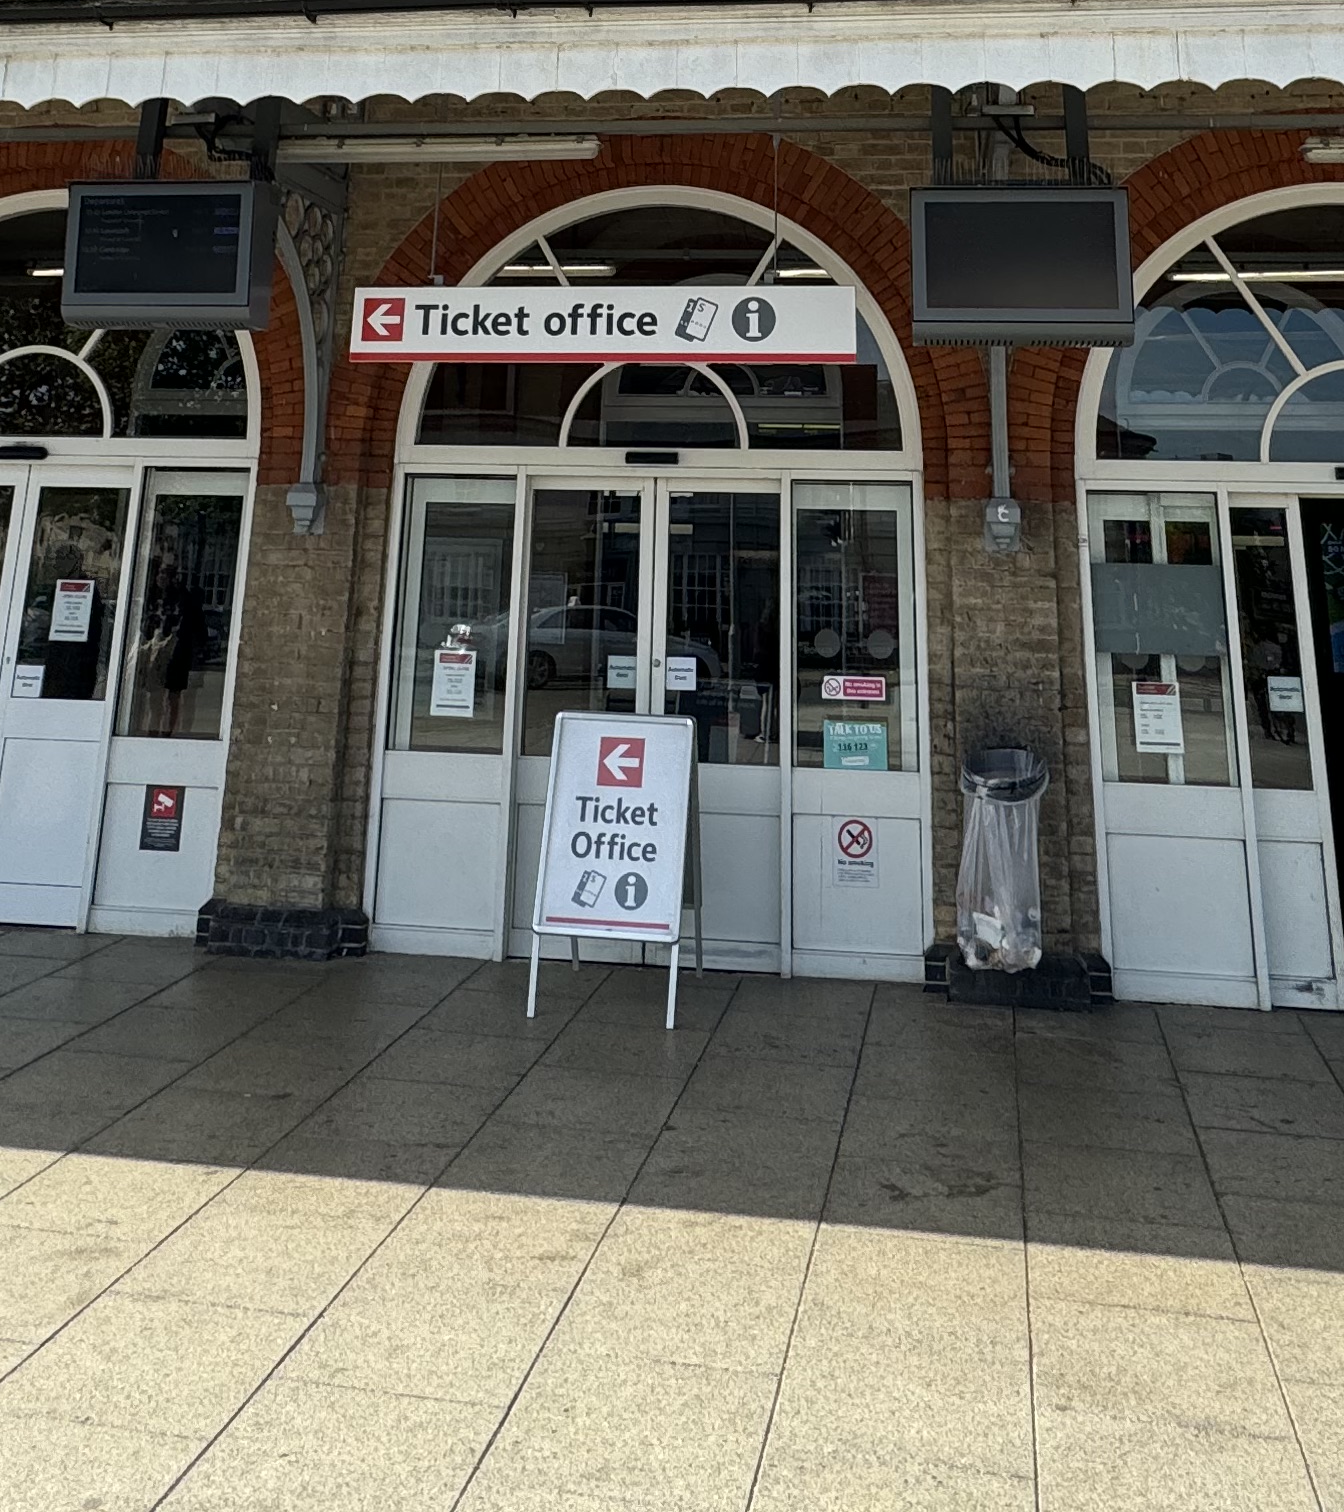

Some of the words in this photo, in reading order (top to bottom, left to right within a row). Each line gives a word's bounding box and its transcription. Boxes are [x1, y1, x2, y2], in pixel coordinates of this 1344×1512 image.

[415, 303, 531, 336] Ticket
[543, 302, 659, 336] office
[829, 722, 853, 736] TALK
[853, 724, 868, 735] TO
[868, 723, 883, 734] US
[575, 795, 659, 827] Ticket
[570, 831, 658, 862] Office
[847, 860, 874, 868] smoking
